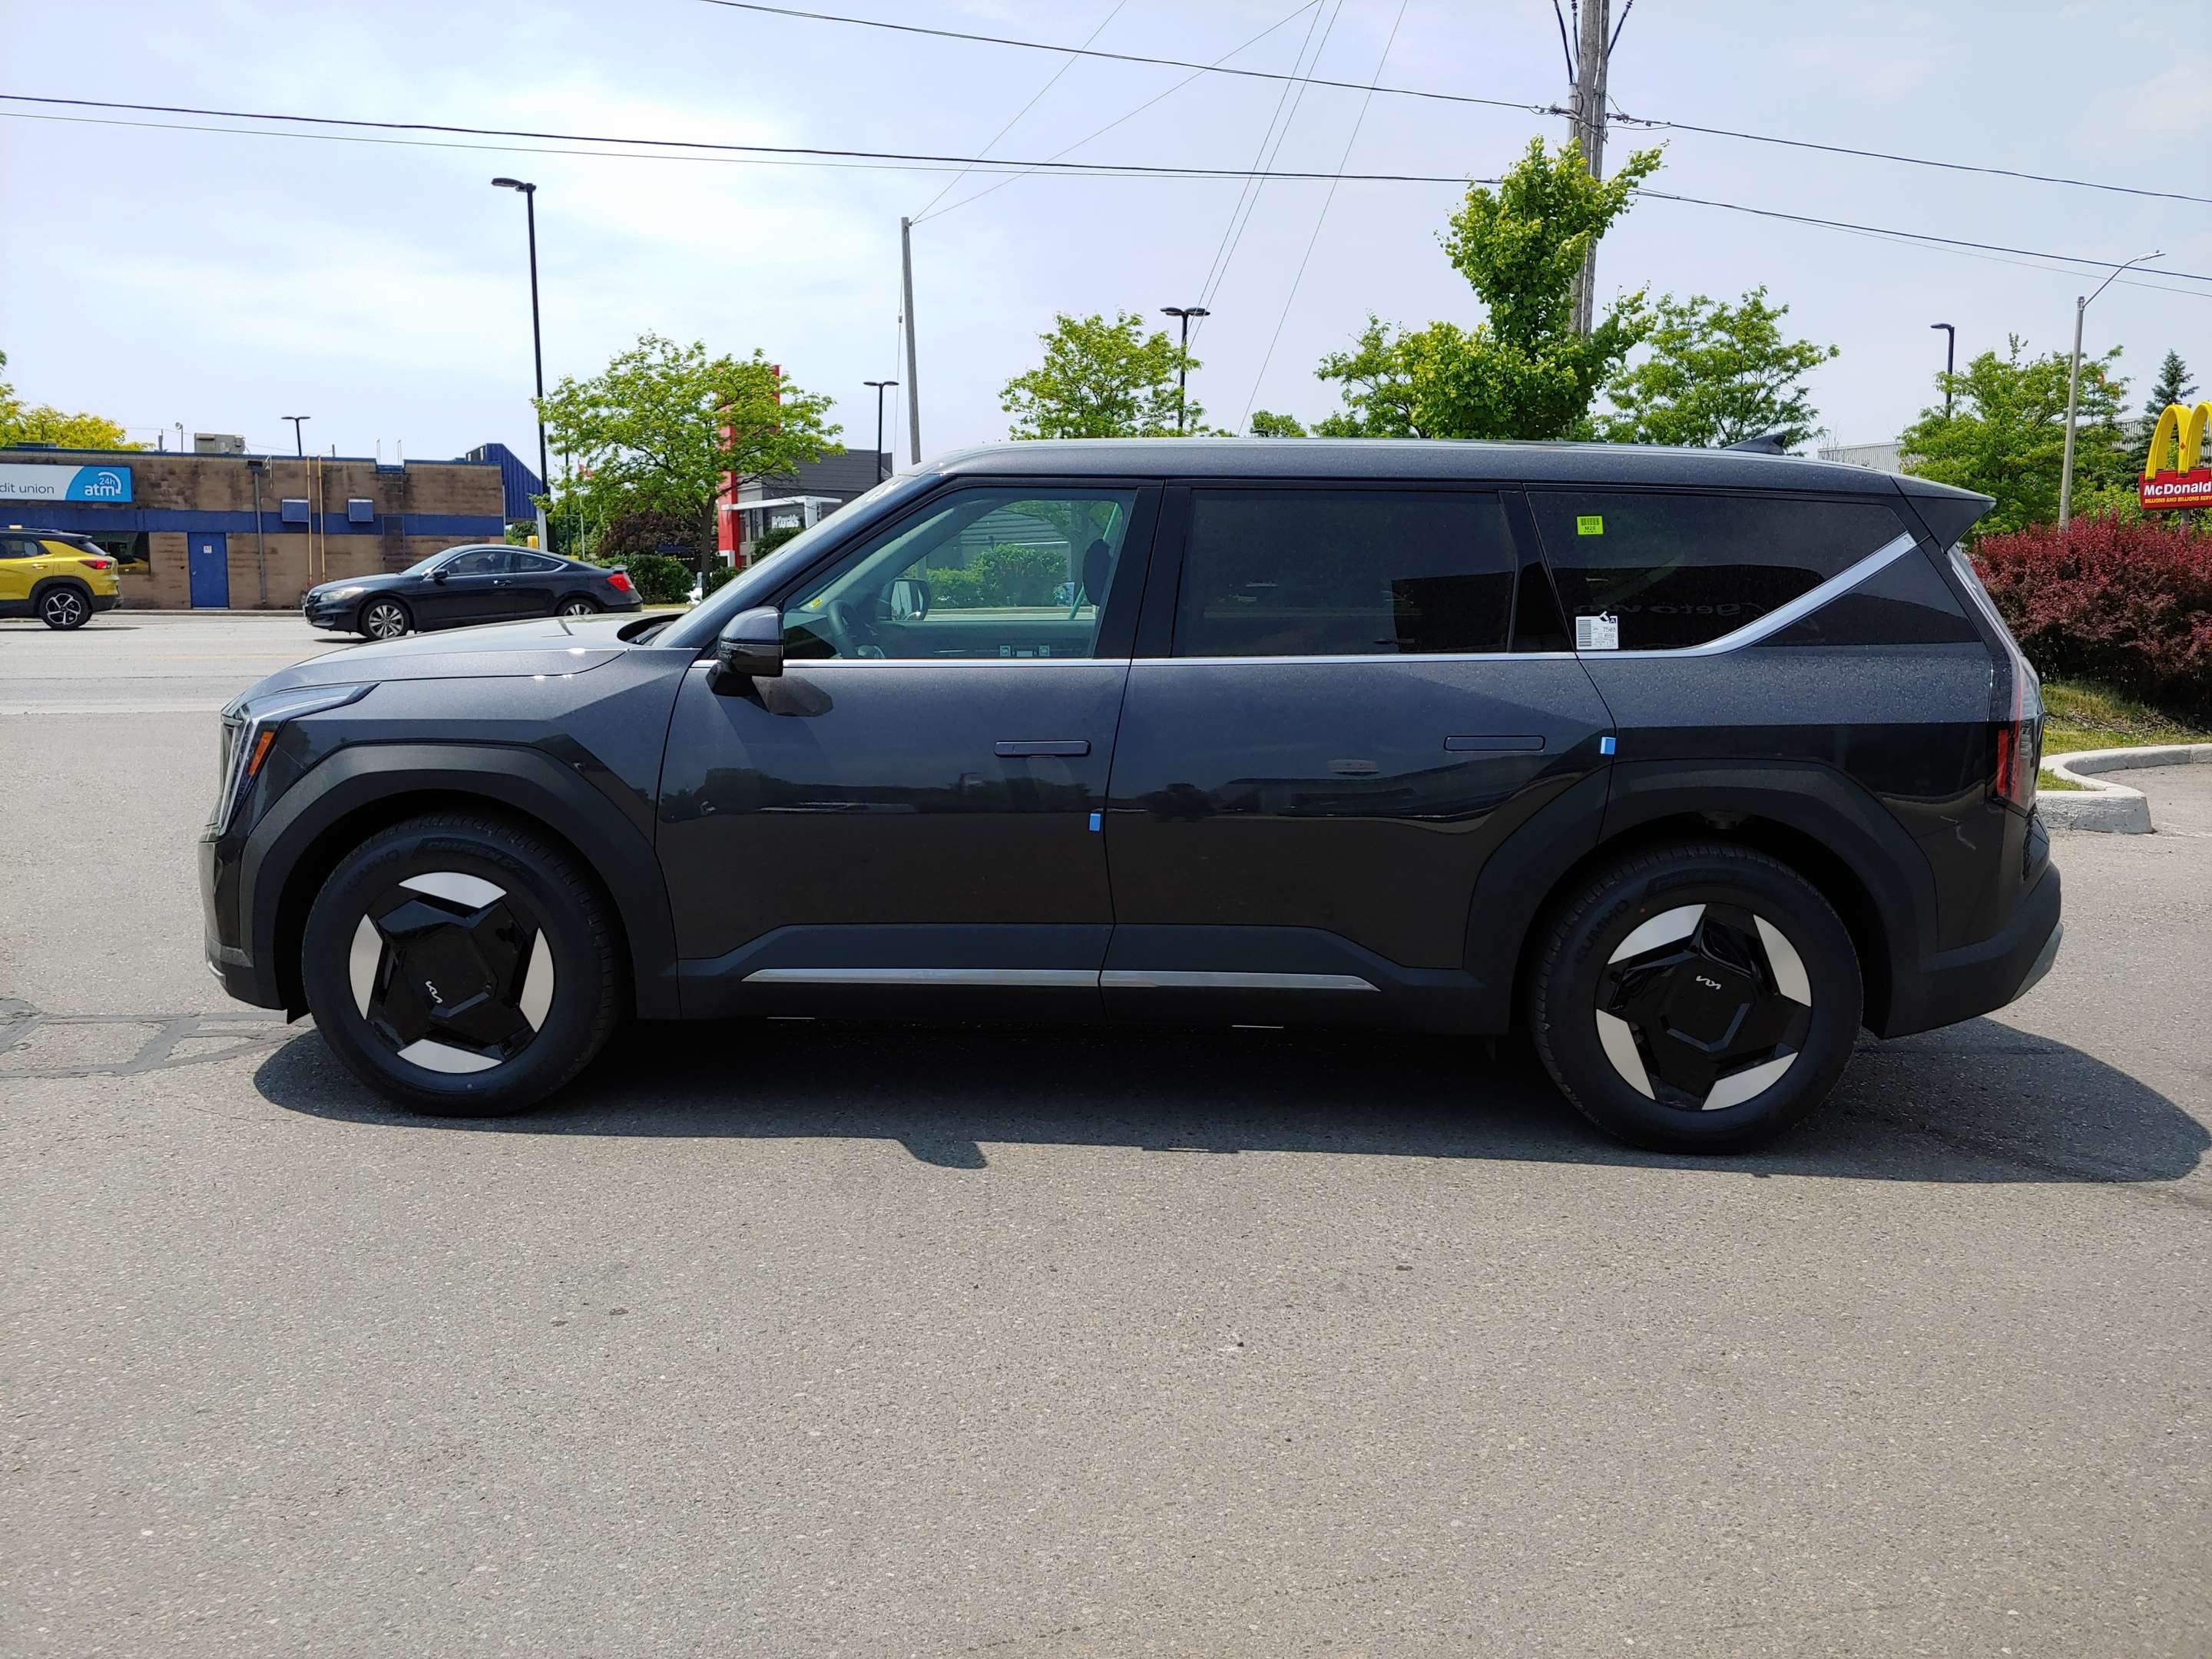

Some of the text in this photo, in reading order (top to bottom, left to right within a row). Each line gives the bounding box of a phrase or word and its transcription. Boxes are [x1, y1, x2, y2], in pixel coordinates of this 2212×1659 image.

[99, 477, 116, 485] 24h
[0, 482, 55, 494] dit union
[84, 484, 114, 496] atm
[2144, 481, 2212, 496] McDonald
